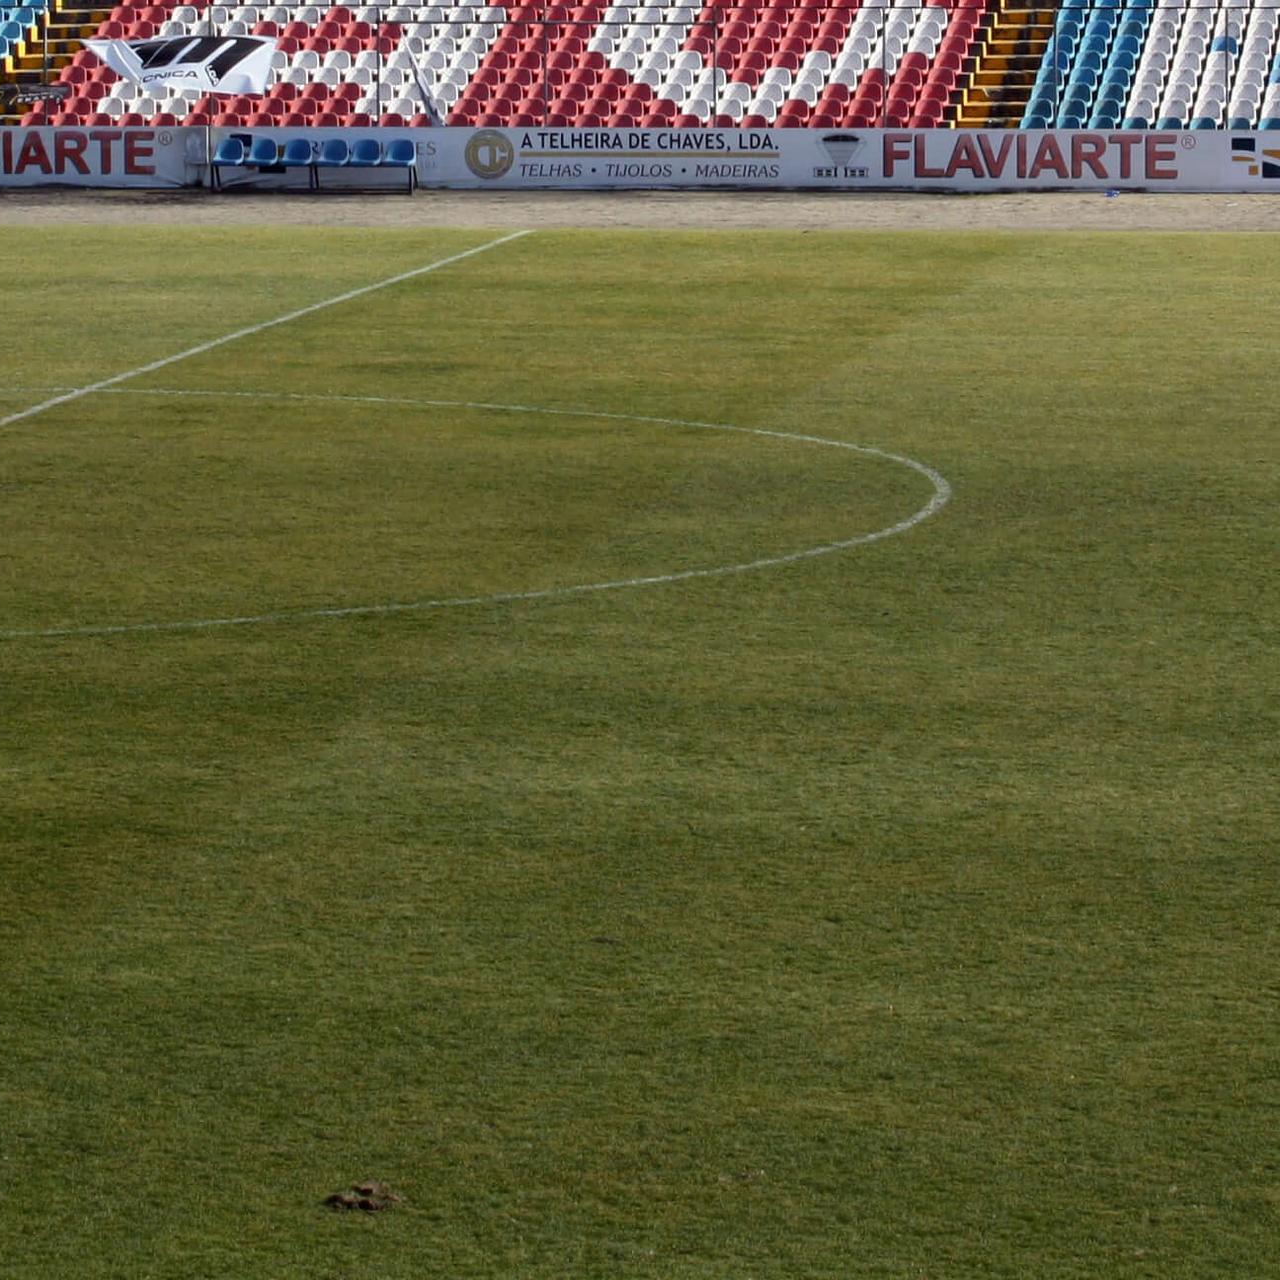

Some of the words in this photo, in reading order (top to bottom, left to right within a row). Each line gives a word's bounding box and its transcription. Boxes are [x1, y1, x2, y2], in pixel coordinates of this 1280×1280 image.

[521, 133, 532, 149] A
[537, 133, 622, 149] TELHEIRA
[628, 133, 649, 149] DE
[657, 133, 731, 152] CHAVES,
[738, 133, 780, 150] LDA.
[883, 133, 1178, 179] FLAVIARTE
[520, 163, 583, 178] TELHAS
[606, 163, 673, 178] TIJOLOS
[695, 164, 780, 178] MADEIRAS
